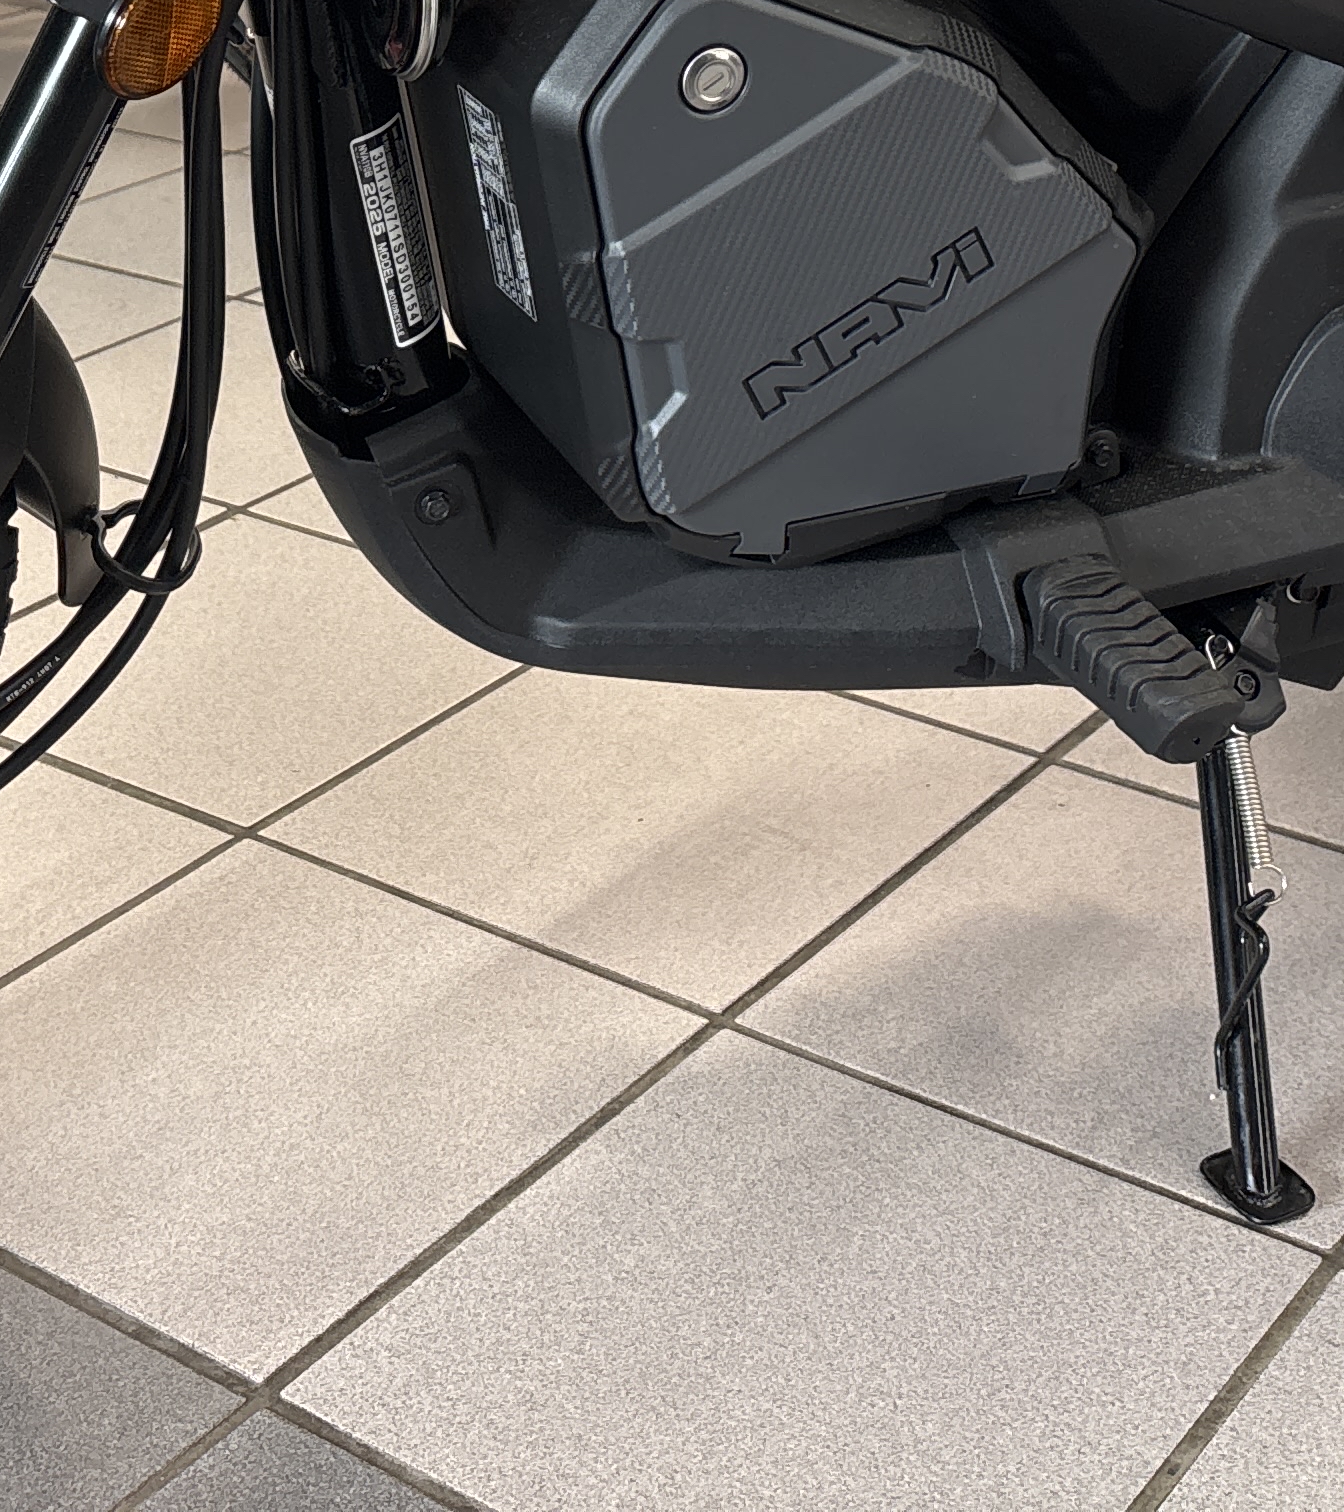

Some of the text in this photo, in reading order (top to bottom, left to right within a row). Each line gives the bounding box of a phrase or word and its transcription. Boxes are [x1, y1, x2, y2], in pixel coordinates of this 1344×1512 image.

[362, 181, 387, 236] 2025
[376, 242, 395, 284] MODEL
[371, 150, 420, 323] 3H1JK0711SD300154
